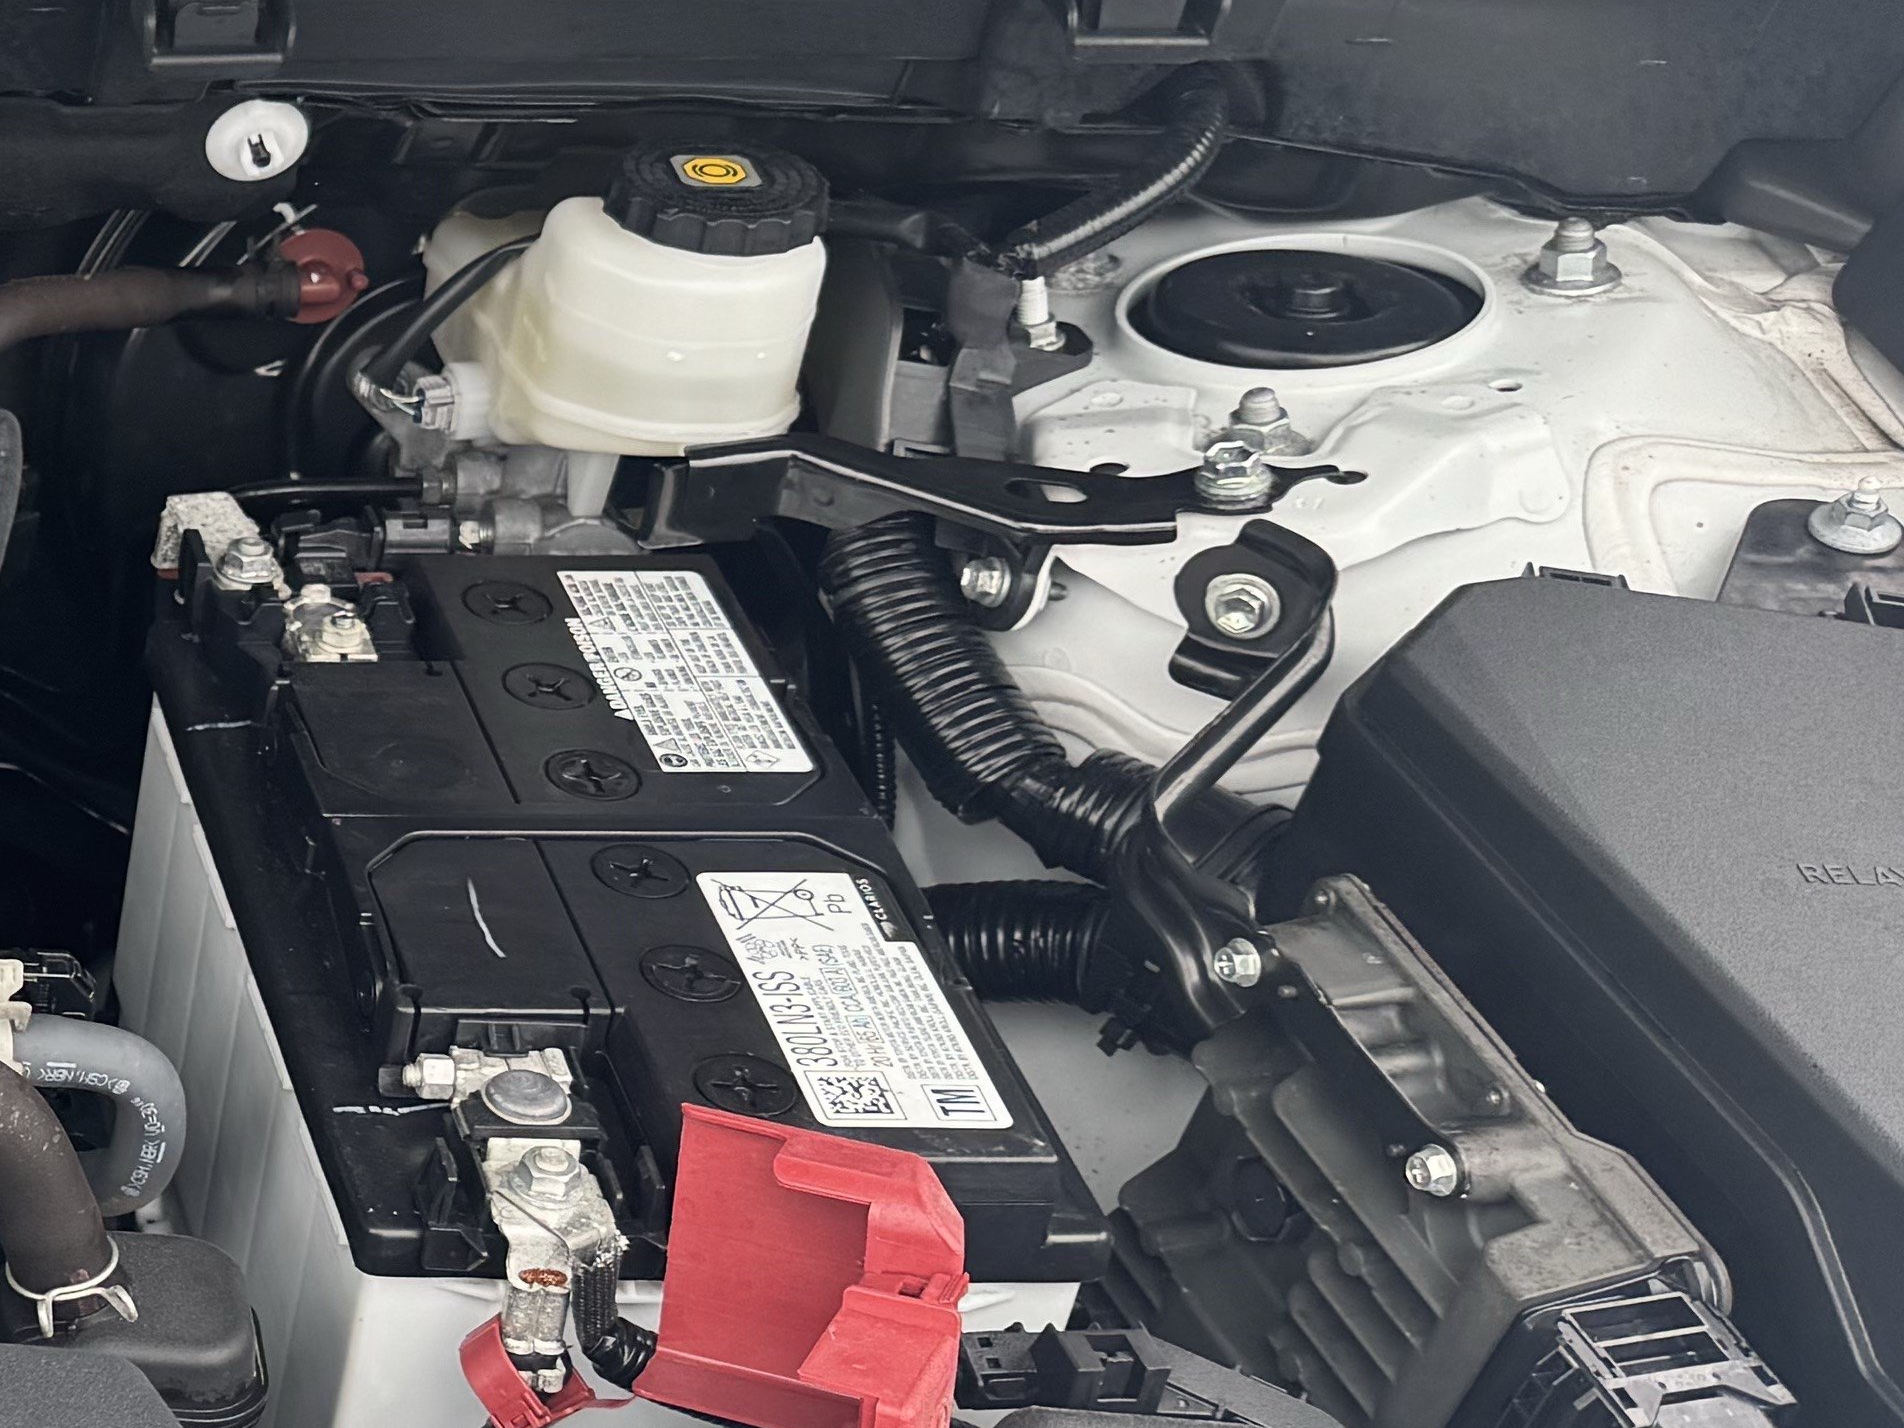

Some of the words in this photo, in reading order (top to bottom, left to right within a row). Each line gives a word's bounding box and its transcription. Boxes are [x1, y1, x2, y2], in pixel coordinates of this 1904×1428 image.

[821, 893, 853, 914] Pb
[856, 878, 887, 920] CLARIOS
[752, 971, 838, 1067] 380LN3-ISS
[929, 1088, 986, 1116] TM
